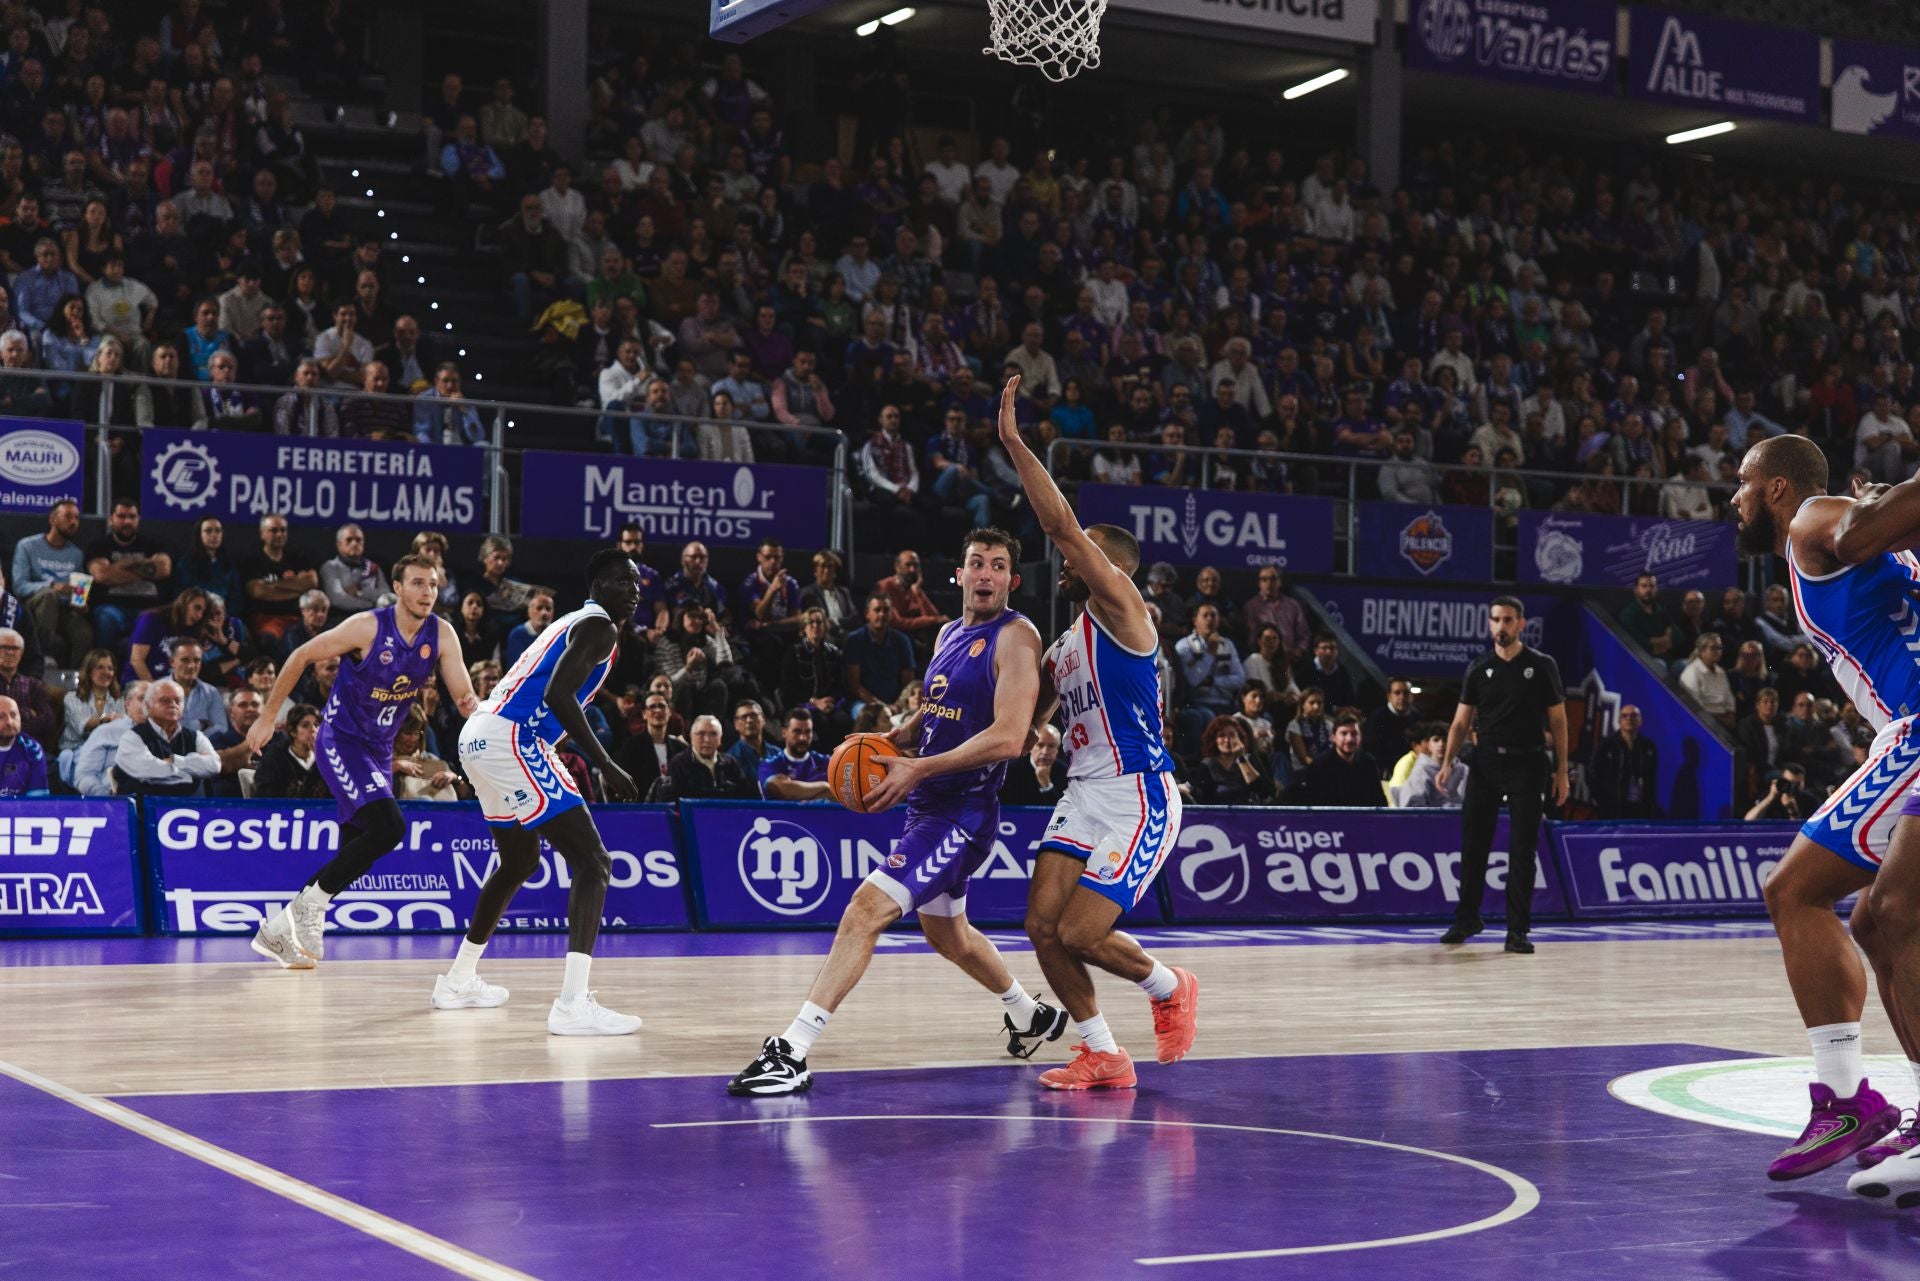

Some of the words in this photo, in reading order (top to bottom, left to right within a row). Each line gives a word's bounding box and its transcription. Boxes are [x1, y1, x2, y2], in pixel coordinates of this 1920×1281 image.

[1475, 15, 1611, 82] Valdés
[1661, 65, 1724, 100] ALDE
[5, 449, 63, 465] MAURI
[277, 446, 433, 478] FERRETERÍA
[0, 490, 78, 507] alenzuela
[230, 475, 336, 518] PABLO
[348, 481, 475, 525] LLAMAS
[1393, 640, 1486, 653] SENTIMIENTO
[377, 705, 397, 726] 13
[1257, 825, 1345, 853] súper
[0, 872, 105, 915] TRA
